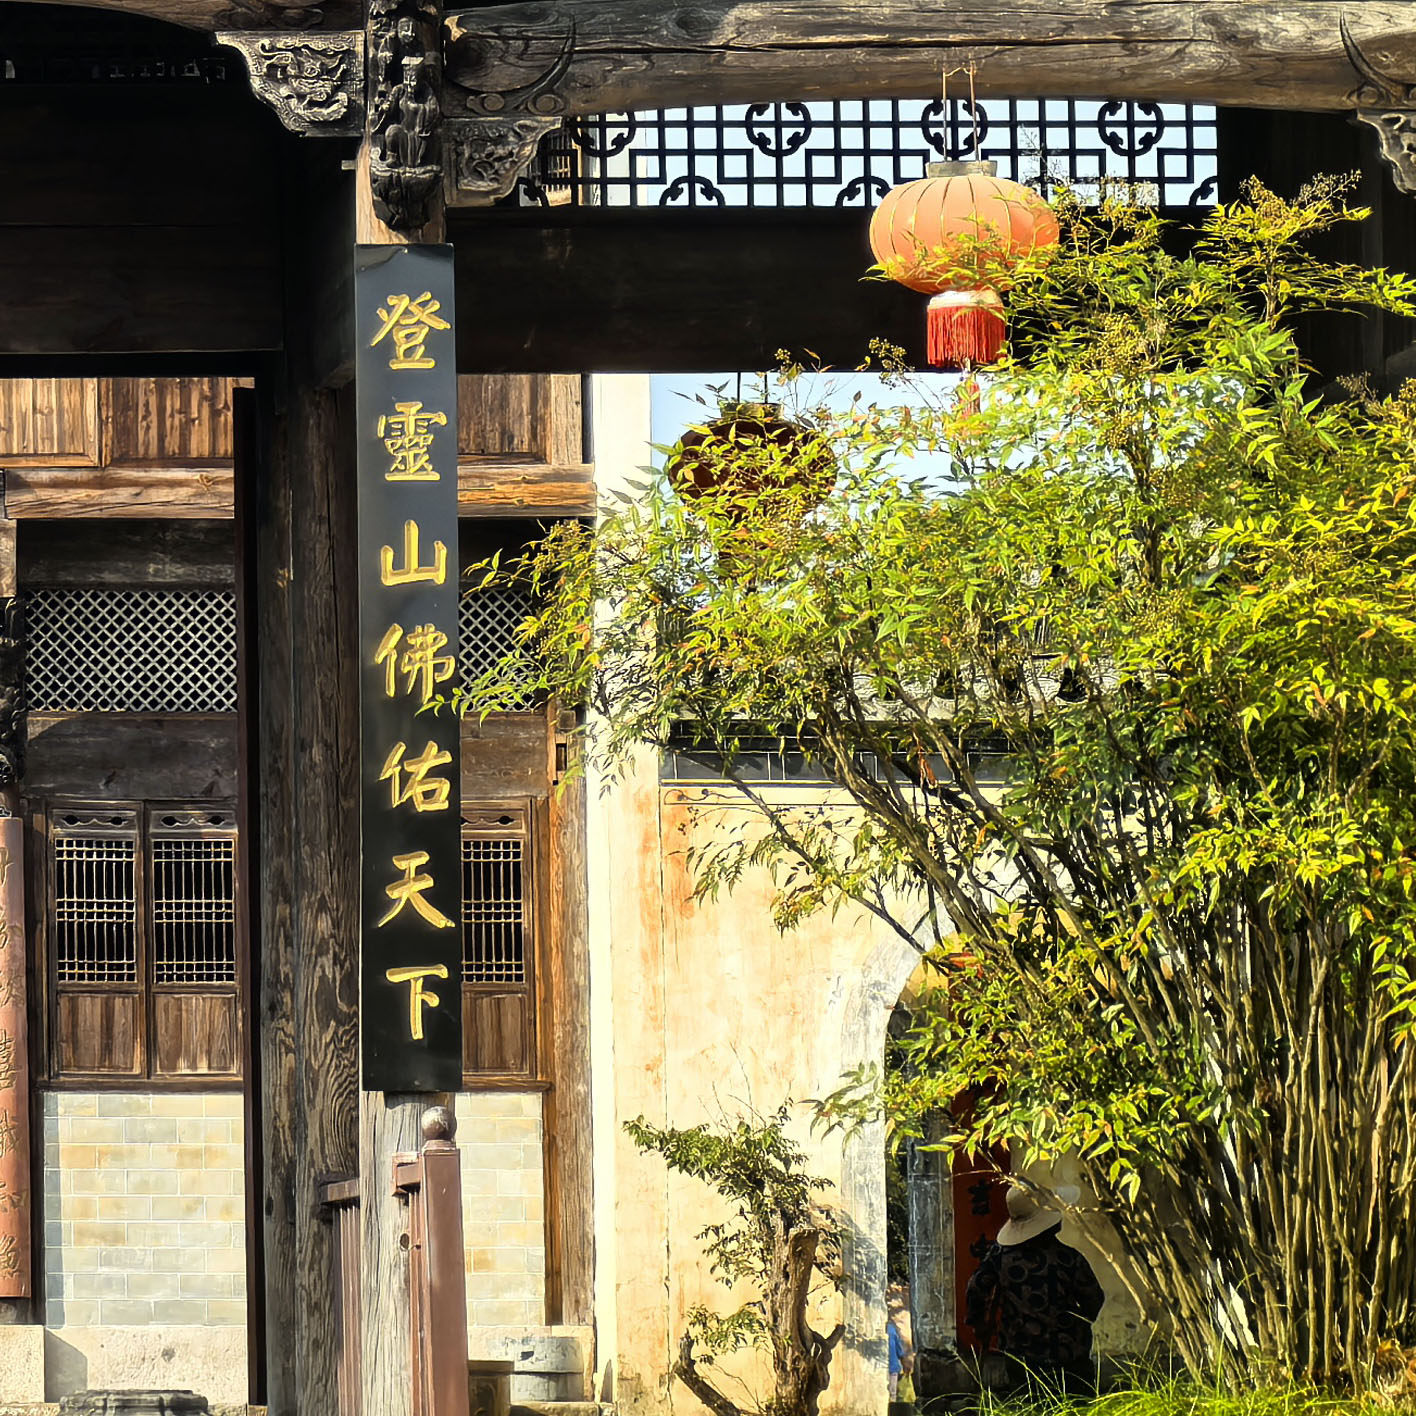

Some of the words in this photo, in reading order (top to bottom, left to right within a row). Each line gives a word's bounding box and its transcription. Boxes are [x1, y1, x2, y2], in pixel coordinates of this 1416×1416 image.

[371, 292, 456, 1040] 登靈山佛佑天下
